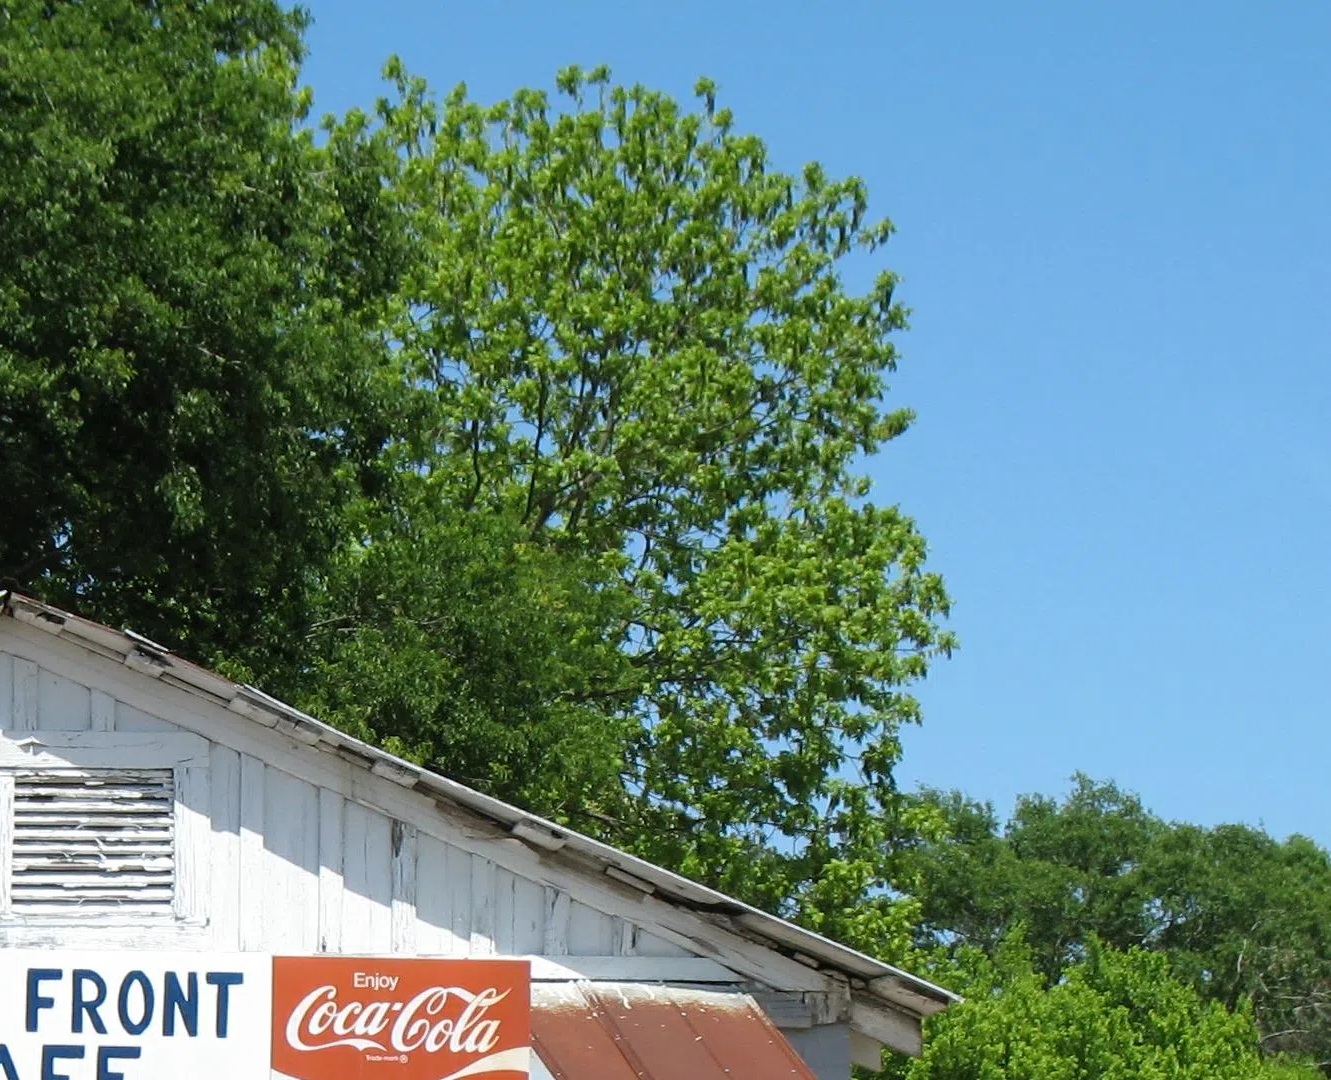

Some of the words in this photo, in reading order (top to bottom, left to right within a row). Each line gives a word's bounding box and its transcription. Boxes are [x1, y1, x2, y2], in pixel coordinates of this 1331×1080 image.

[25, 967, 244, 1038] FRONT
[352, 972, 399, 991] Enjoy
[285, 985, 512, 1053] Coca-Cola
